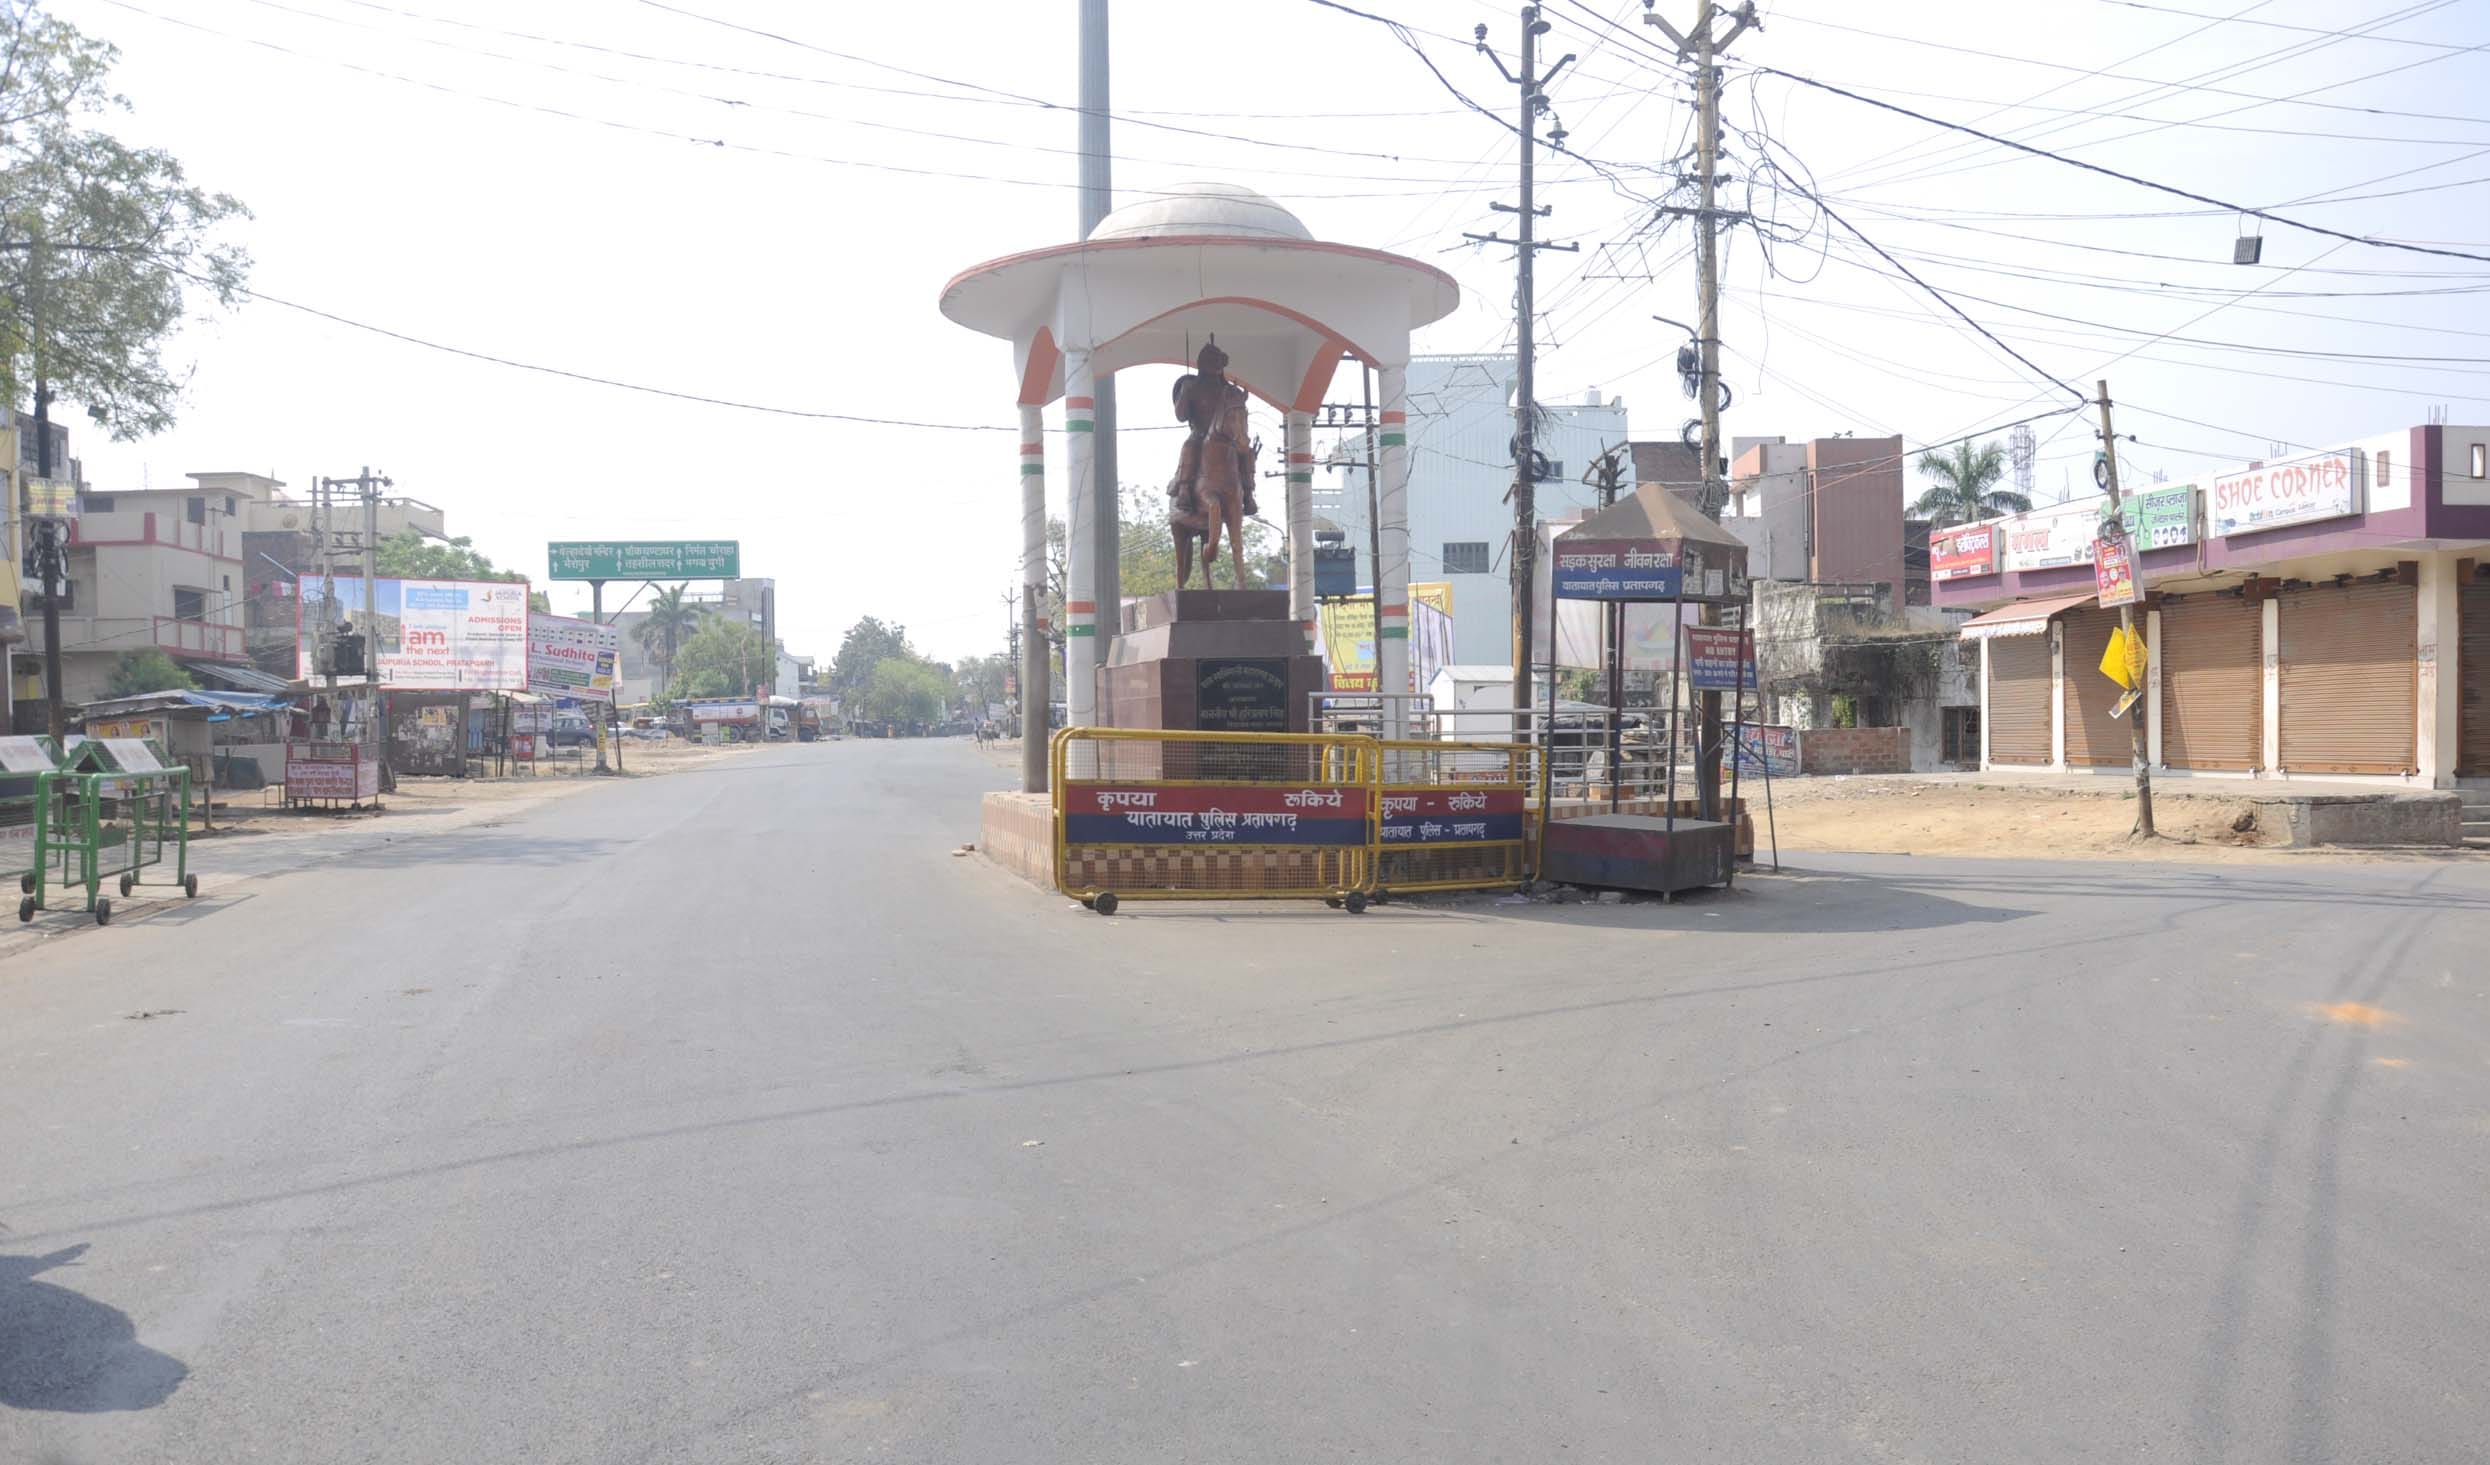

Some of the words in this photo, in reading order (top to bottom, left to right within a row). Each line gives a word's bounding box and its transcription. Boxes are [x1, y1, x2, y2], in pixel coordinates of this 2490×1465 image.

[2218, 476, 2263, 510] SHOE
[2271, 457, 2348, 499] CORNER
[1559, 554, 1585, 571] सड़क
[1586, 553, 1616, 573] सुरक्षा
[1624, 547, 1653, 569] जीवन
[1653, 552, 1674, 568] रक्षा
[1595, 577, 1619, 594] पुलिस
[468, 616, 522, 625] ADMISSIONS
[409, 630, 445, 645] am
[406, 646, 424, 655] the
[427, 647, 450, 655] next
[545, 644, 595, 662] Sudhita
[1097, 791, 1157, 811] कृपया
[1380, 796, 1418, 820] कृपया
[1126, 811, 1194, 828] यातायात
[1199, 807, 1238, 830] पुलिस
[1241, 812, 1298, 831] प्रतापगढ़
[1185, 830, 1207, 841] उत्तर
[1210, 829, 1236, 841] प्रदेश
[1419, 821, 1443, 840] पुलिस
